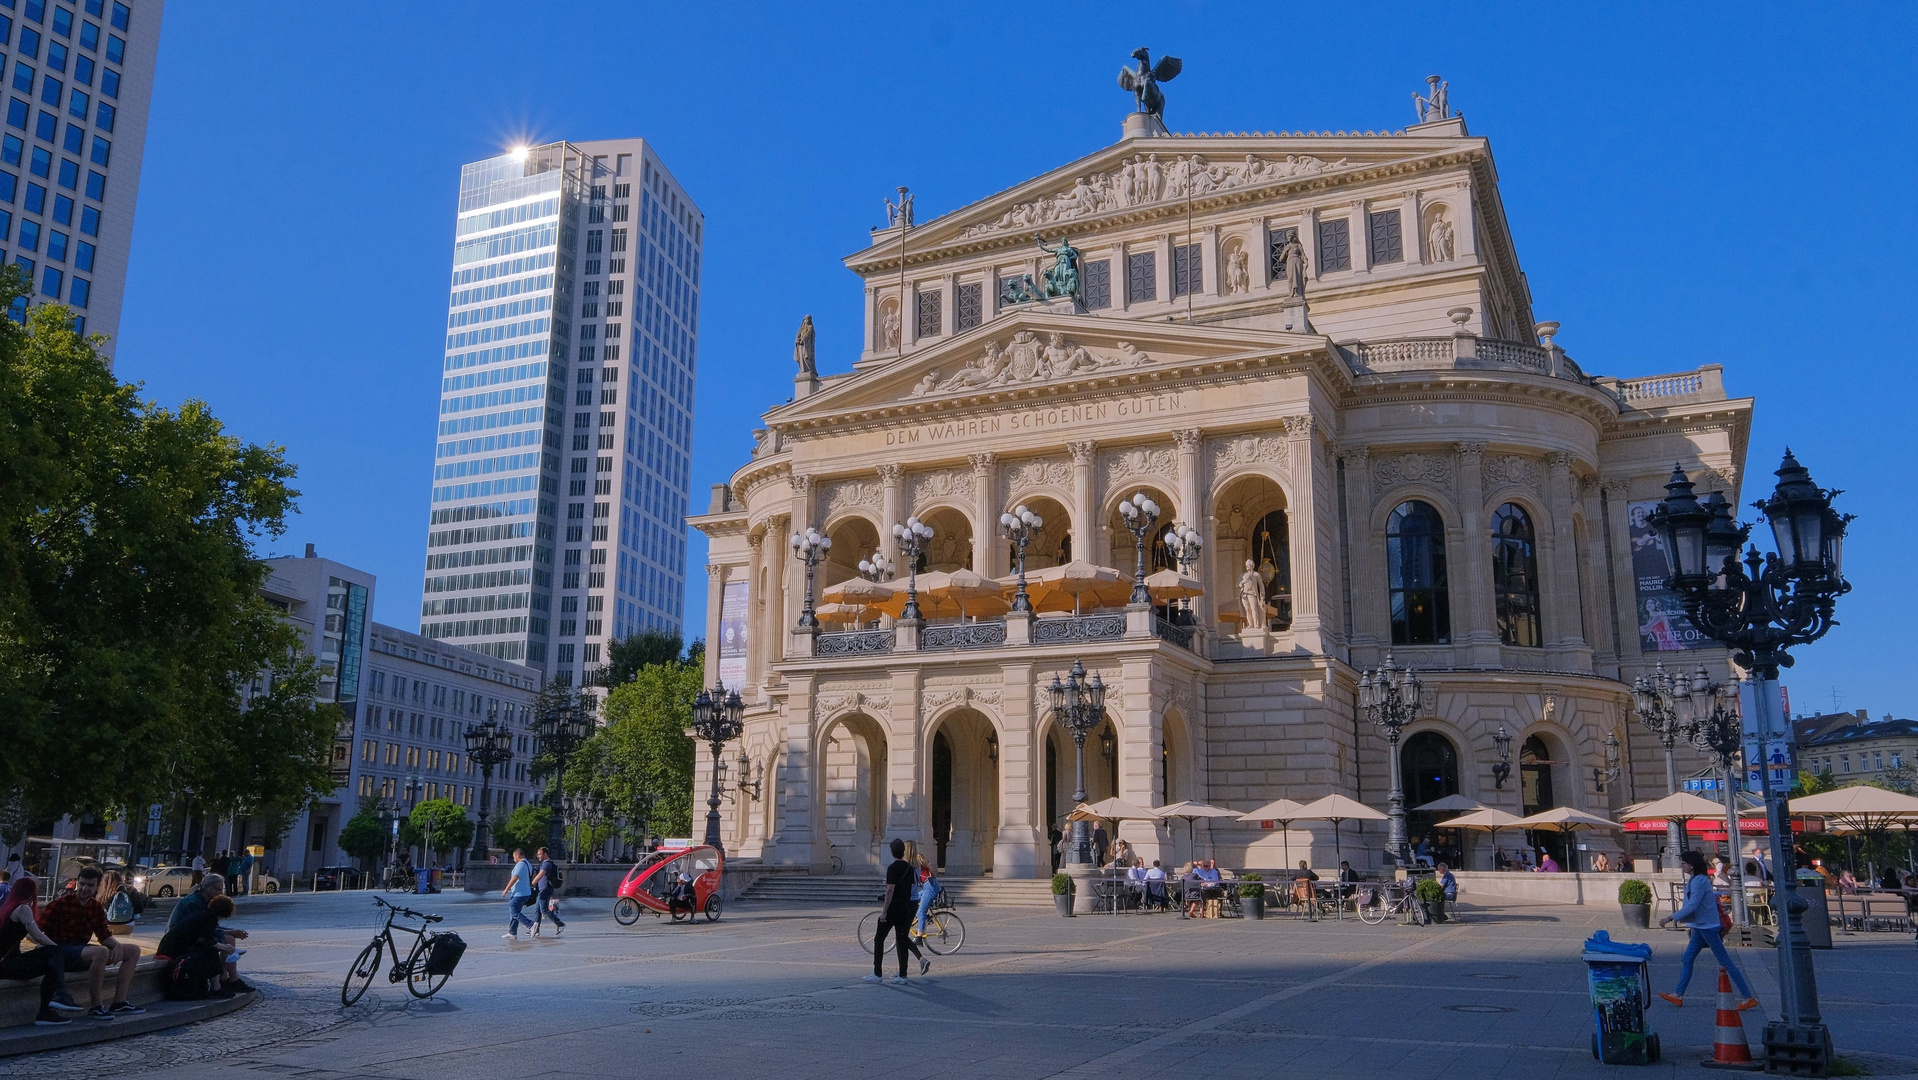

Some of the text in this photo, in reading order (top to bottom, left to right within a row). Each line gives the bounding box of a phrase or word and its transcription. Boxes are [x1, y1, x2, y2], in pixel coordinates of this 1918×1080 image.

[886, 395, 1188, 446] DEM WAHREN SCHOENEN GUTEN.
[1646, 631, 1681, 642] ALTE
